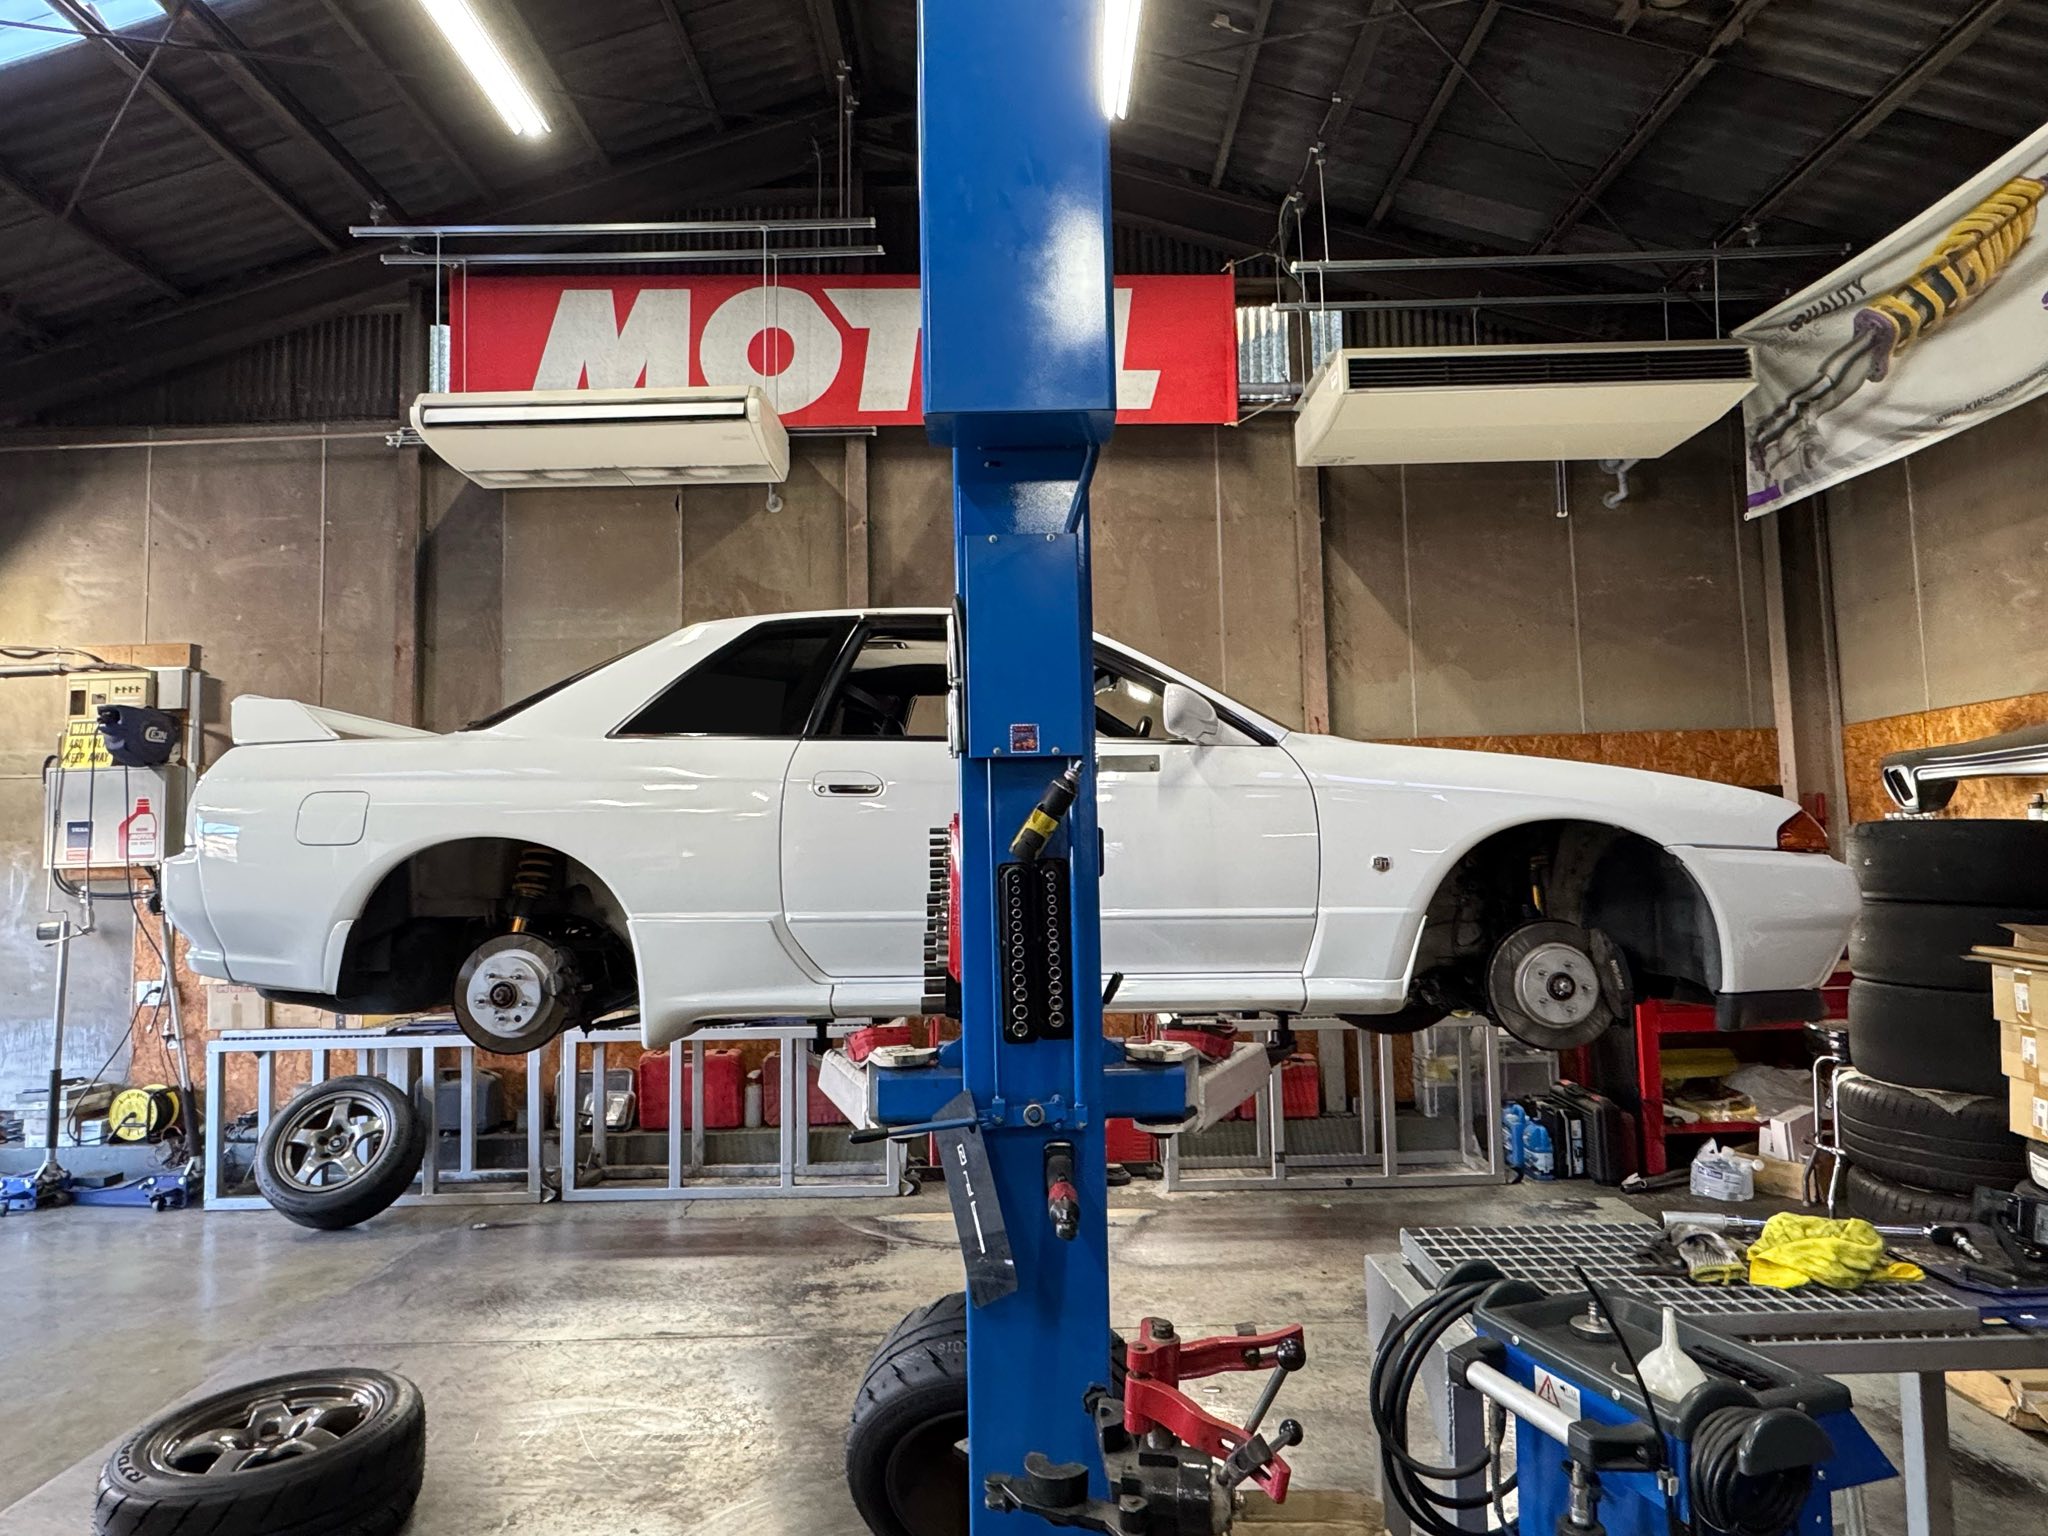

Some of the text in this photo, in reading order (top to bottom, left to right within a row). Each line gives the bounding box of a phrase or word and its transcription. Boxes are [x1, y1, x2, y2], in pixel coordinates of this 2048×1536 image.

[1788, 275, 1867, 332] QUALITY
[532, 286, 1161, 415] MOTL
[65, 752, 86, 764] KEEP
